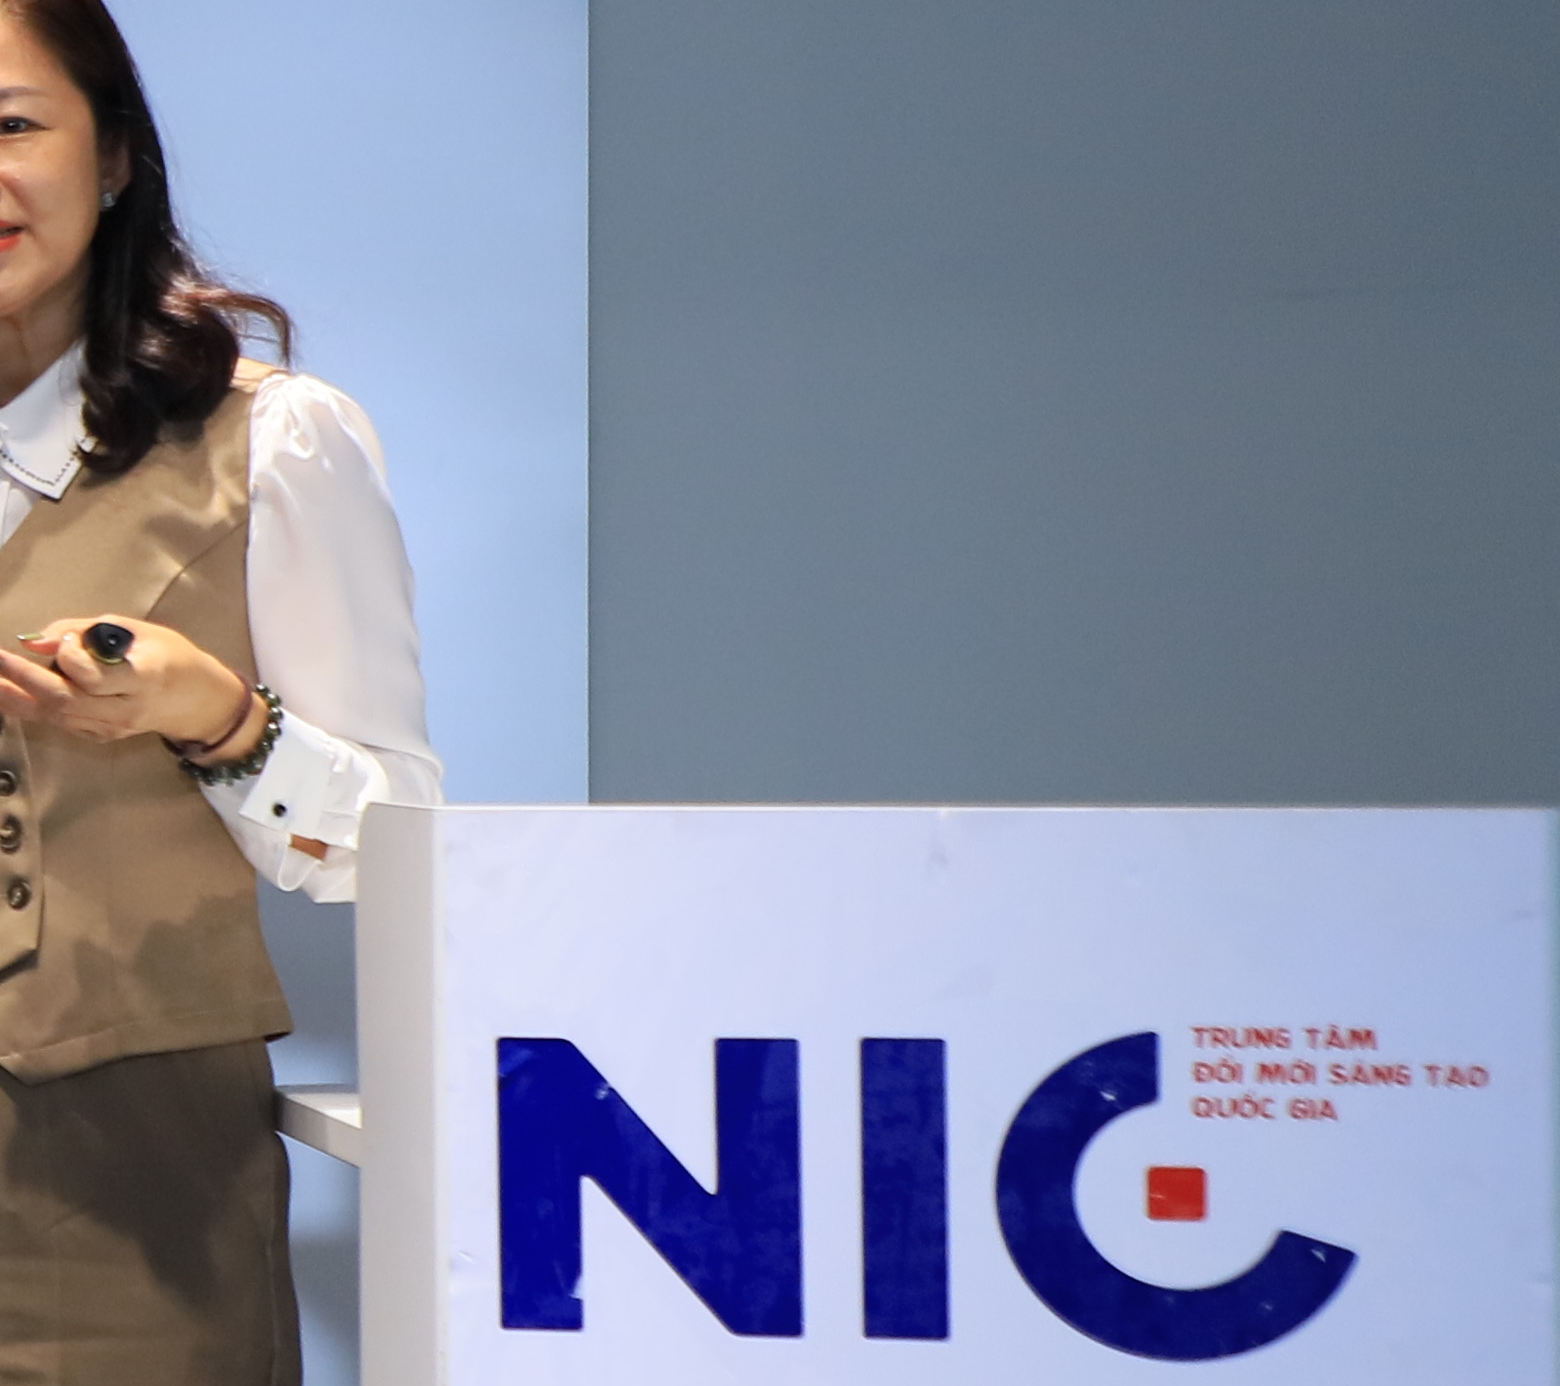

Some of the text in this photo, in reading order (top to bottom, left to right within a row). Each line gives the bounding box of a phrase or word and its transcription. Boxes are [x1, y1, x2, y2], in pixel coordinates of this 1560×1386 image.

[1191, 1023, 1379, 1051] TRUNG TÂM
[1288, 1097, 1339, 1121] GIA
[496, 1031, 1359, 1363] NIC
